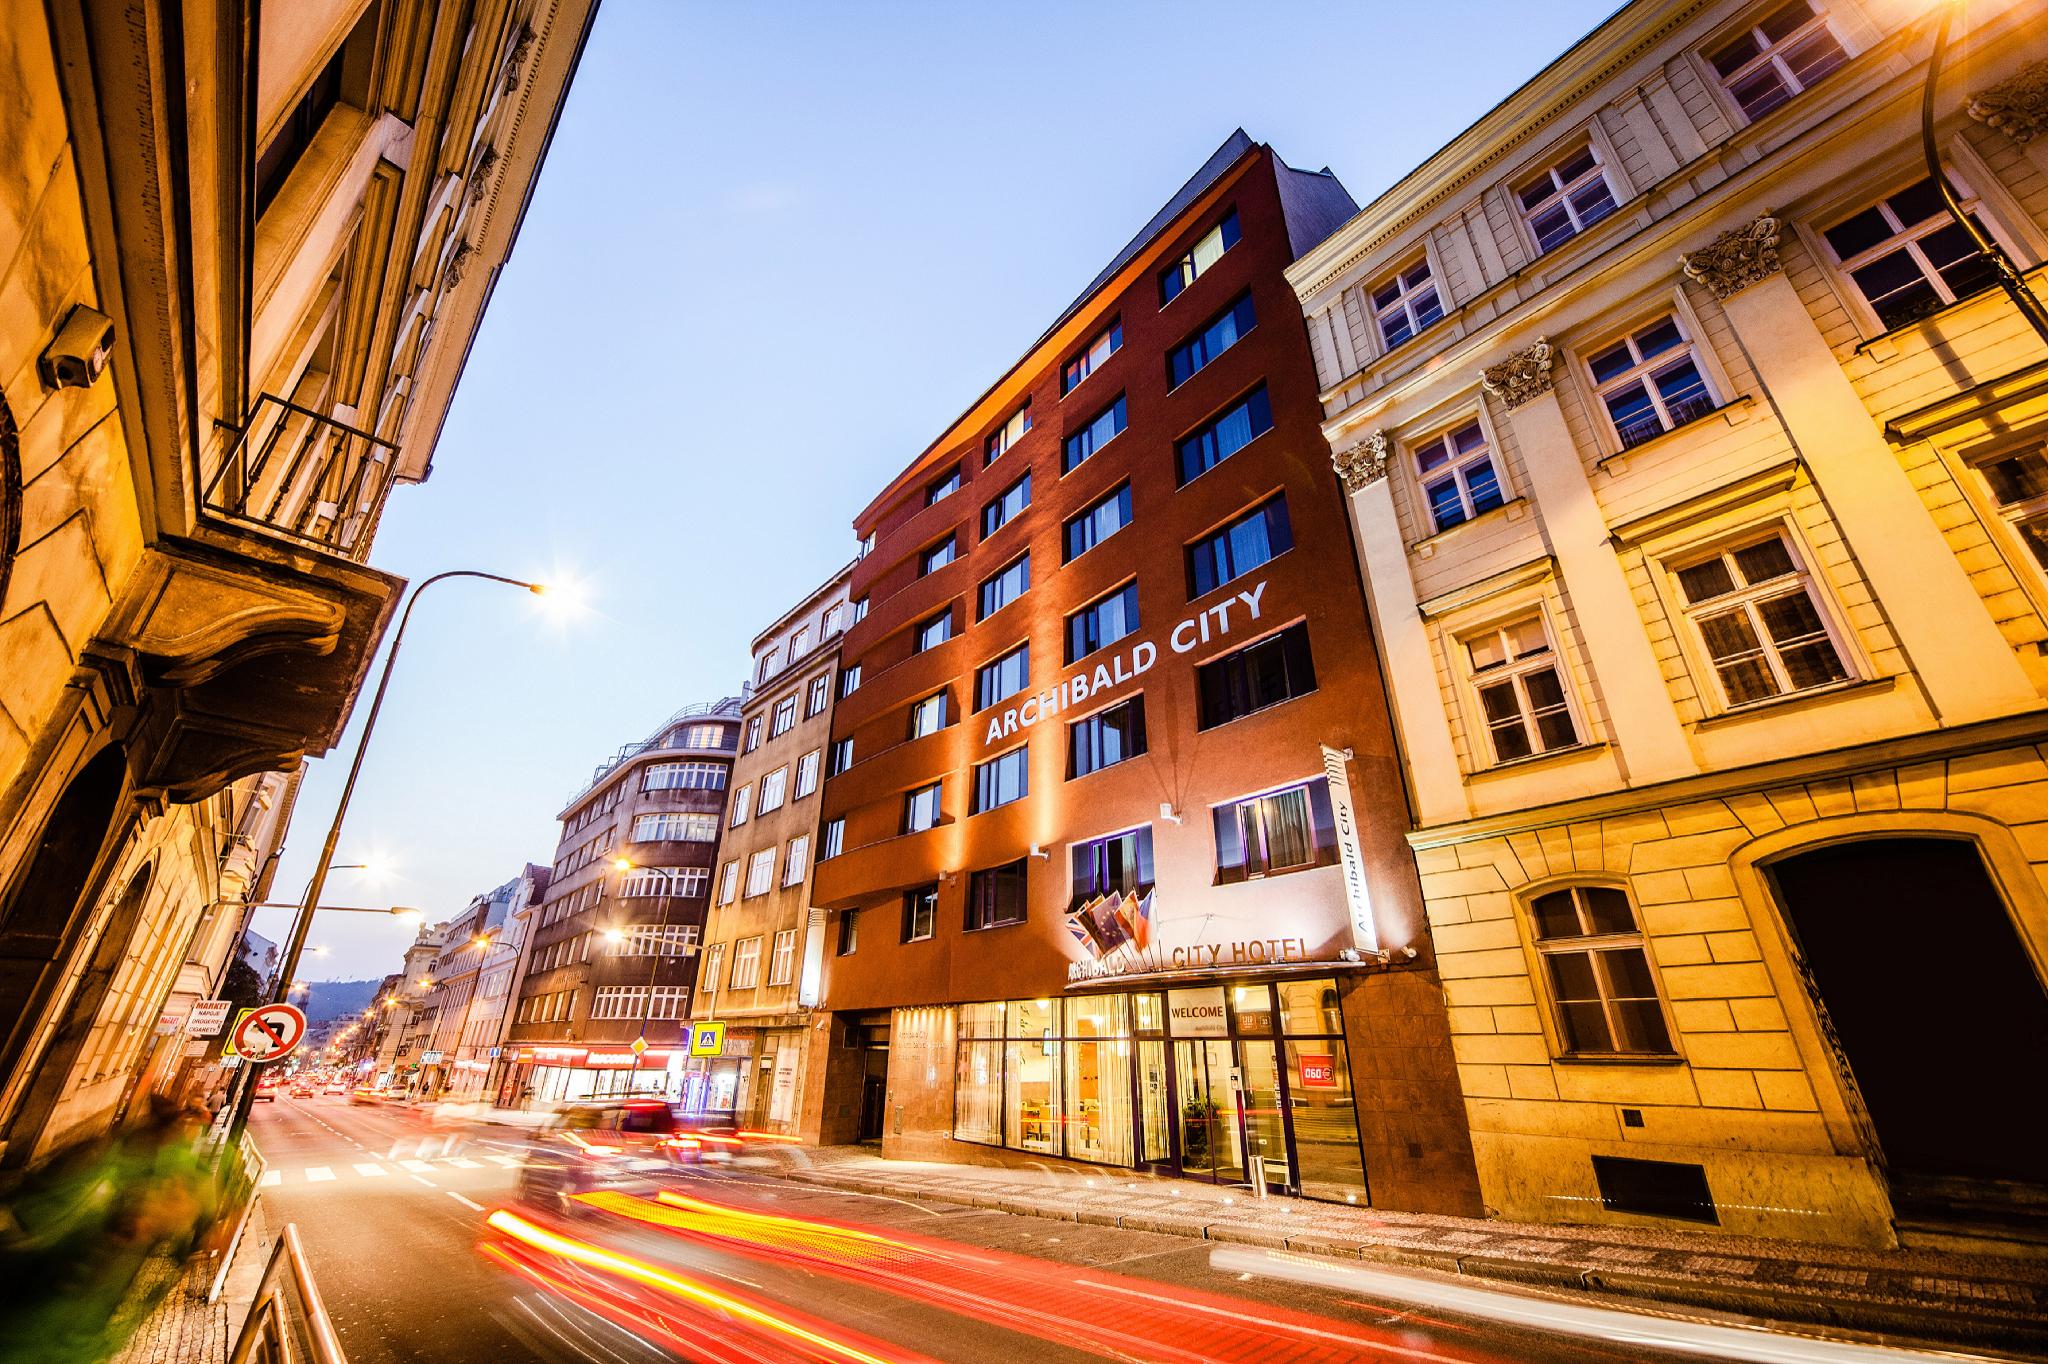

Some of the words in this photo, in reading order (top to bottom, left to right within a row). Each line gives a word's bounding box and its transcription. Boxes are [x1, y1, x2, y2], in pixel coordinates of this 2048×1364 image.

[985, 641, 1157, 745] ARCHIBALD
[1170, 581, 1267, 654] CITY
[1338, 801, 1350, 836] City
[1172, 943, 1221, 966] CITY
[1232, 938, 1311, 963] HOTEL
[1171, 1006, 1224, 1018] WELCOME
